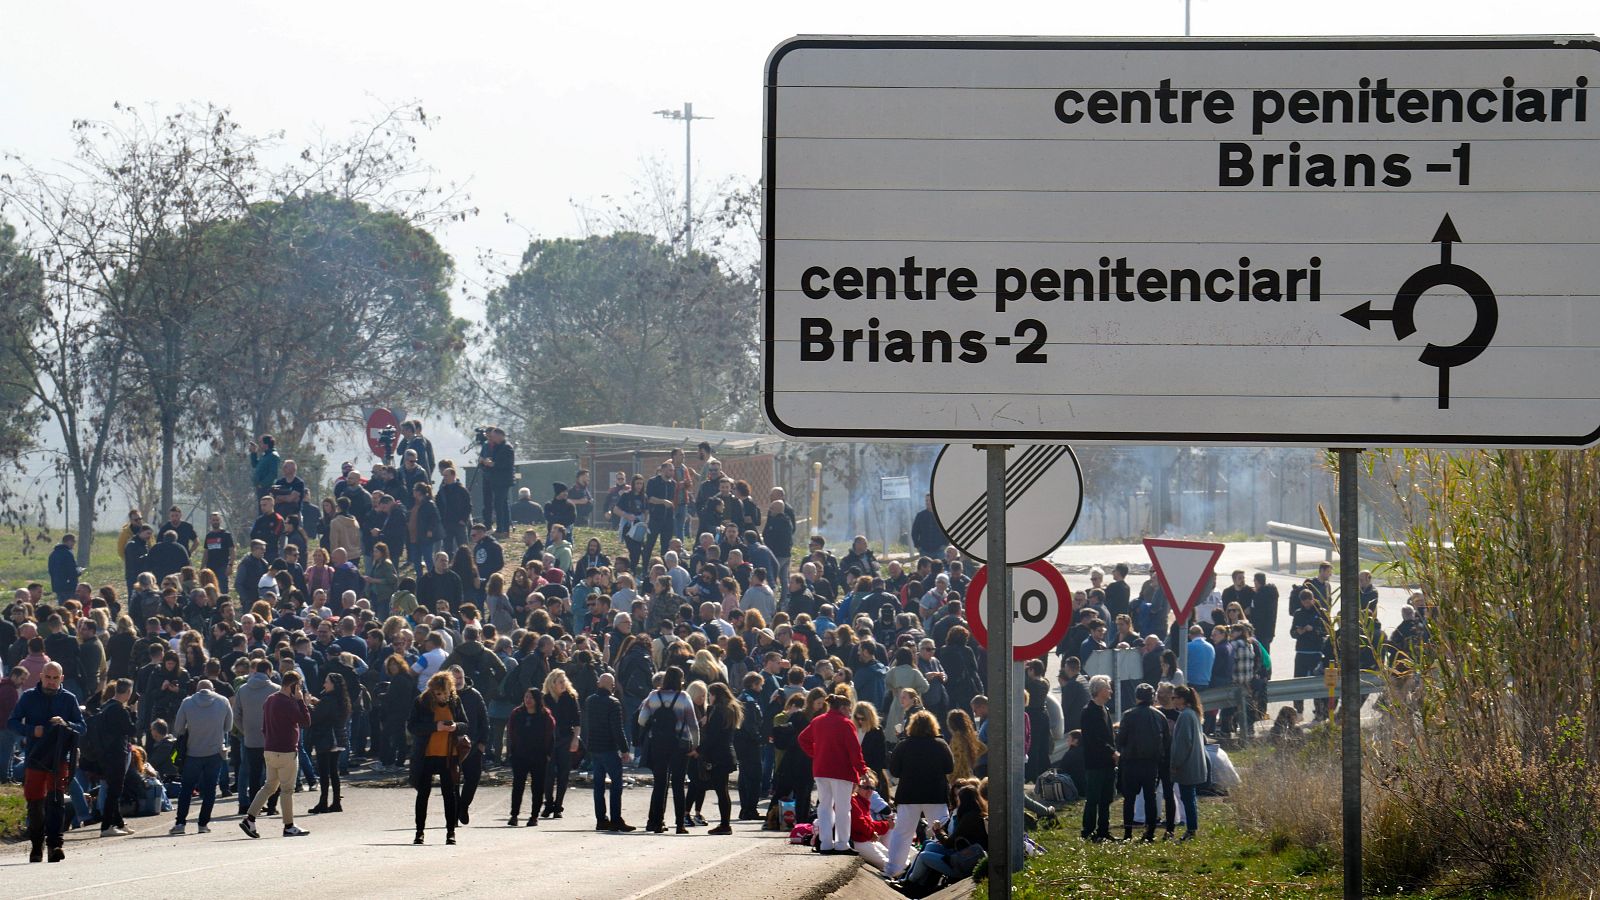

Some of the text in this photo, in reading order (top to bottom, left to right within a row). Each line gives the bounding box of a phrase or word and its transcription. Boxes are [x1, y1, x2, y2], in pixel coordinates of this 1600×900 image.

[1055, 77, 1588, 135] centre penitenciari
[801, 257, 1321, 312] centre penitenciari
[801, 317, 1048, 363] Brians-2
